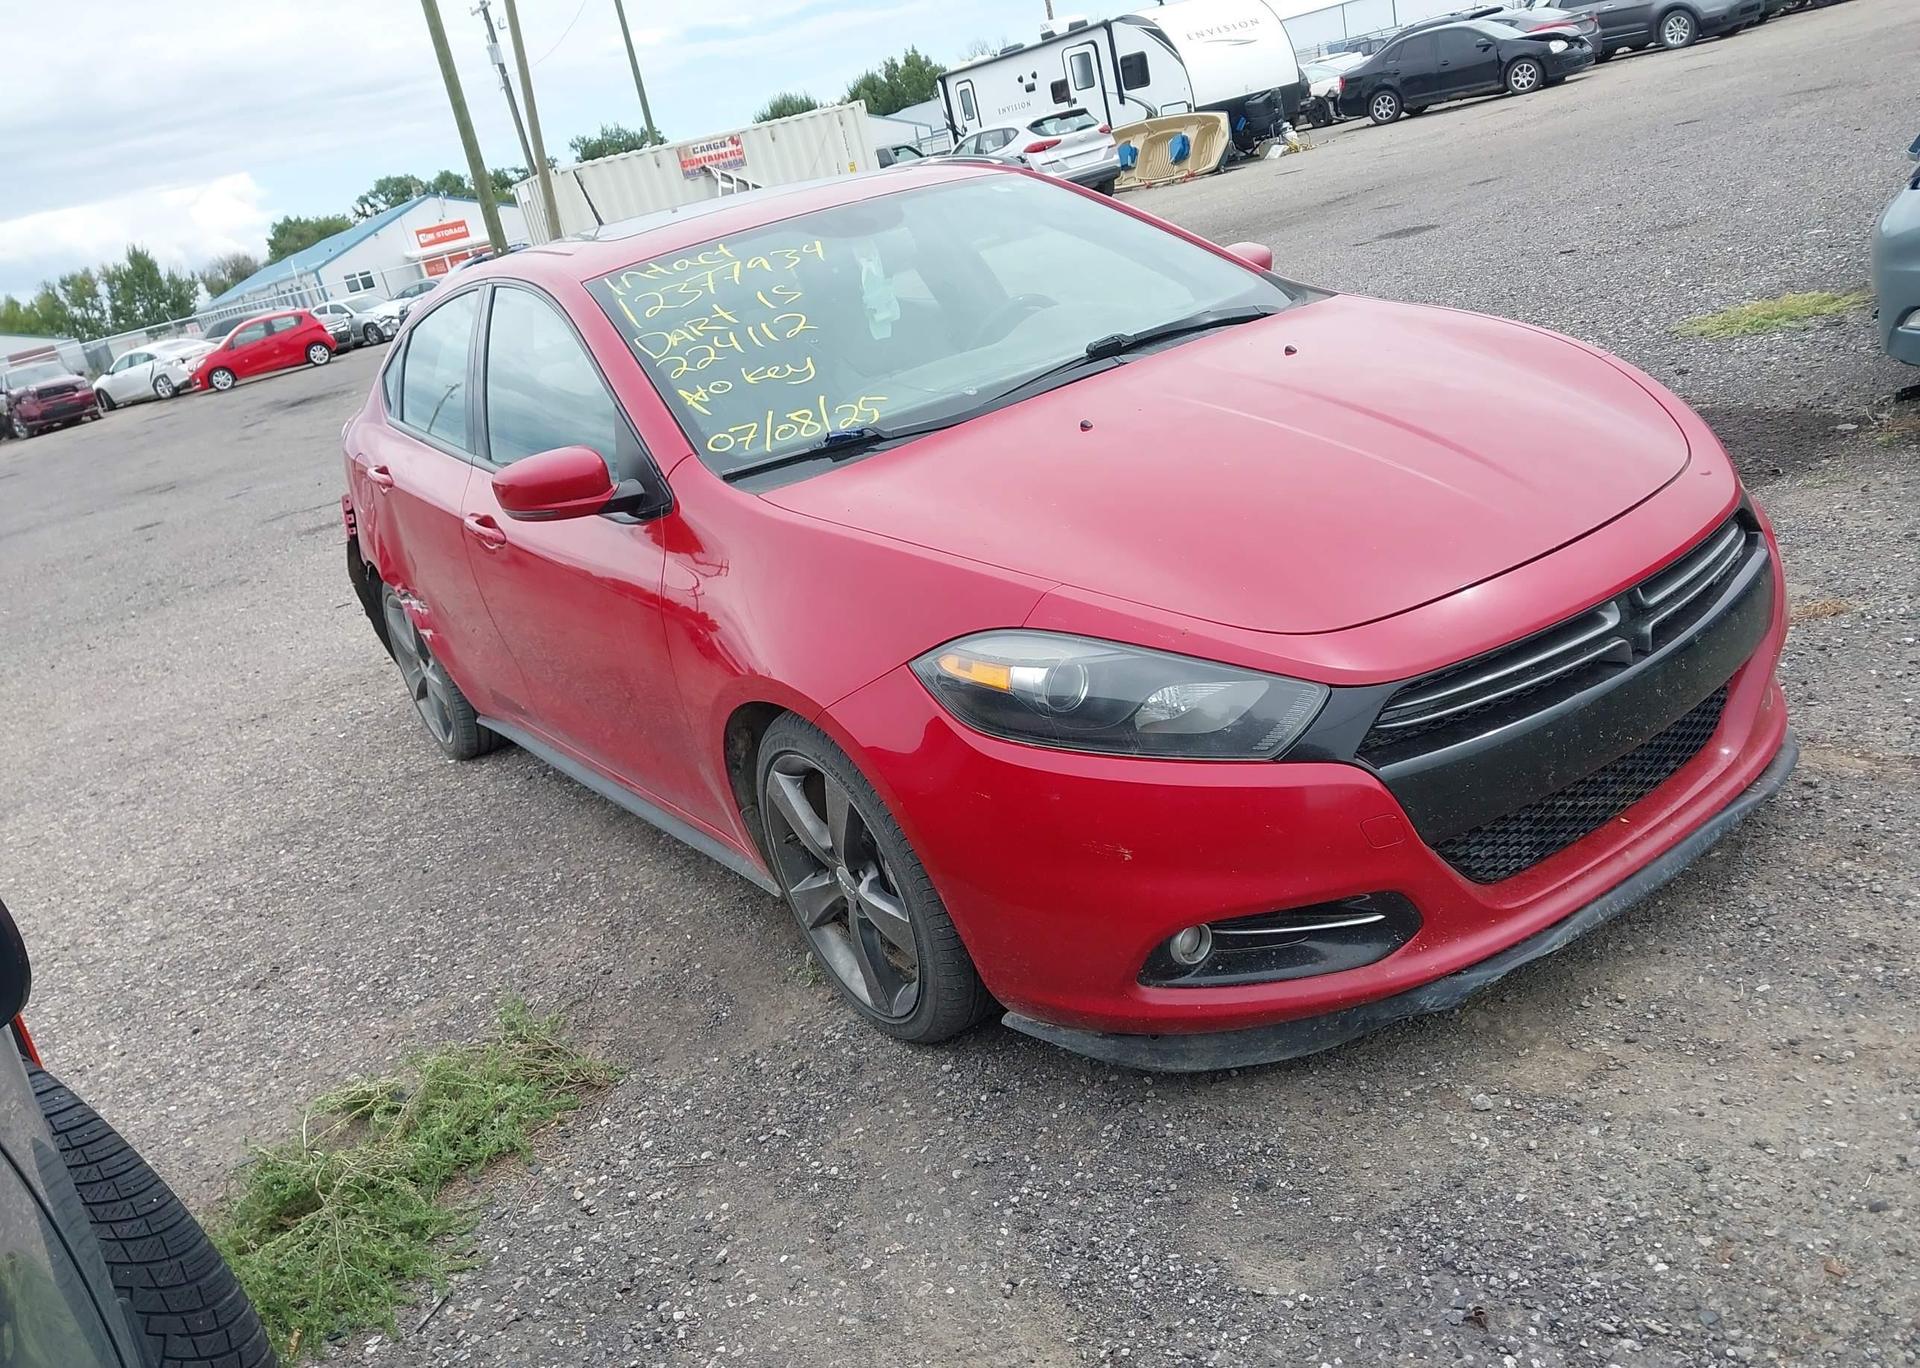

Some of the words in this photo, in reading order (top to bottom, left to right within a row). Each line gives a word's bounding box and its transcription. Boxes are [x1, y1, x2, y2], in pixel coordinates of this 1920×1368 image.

[1186, 18, 1260, 40] ENVISION
[998, 100, 1031, 115] ENVISION
[692, 140, 727, 155] CARGO
[681, 148, 743, 169] CONTAINERS
[436, 225, 467, 238] STORAGE
[655, 313, 819, 380] 224112
[706, 395, 889, 452] 07/08/25
